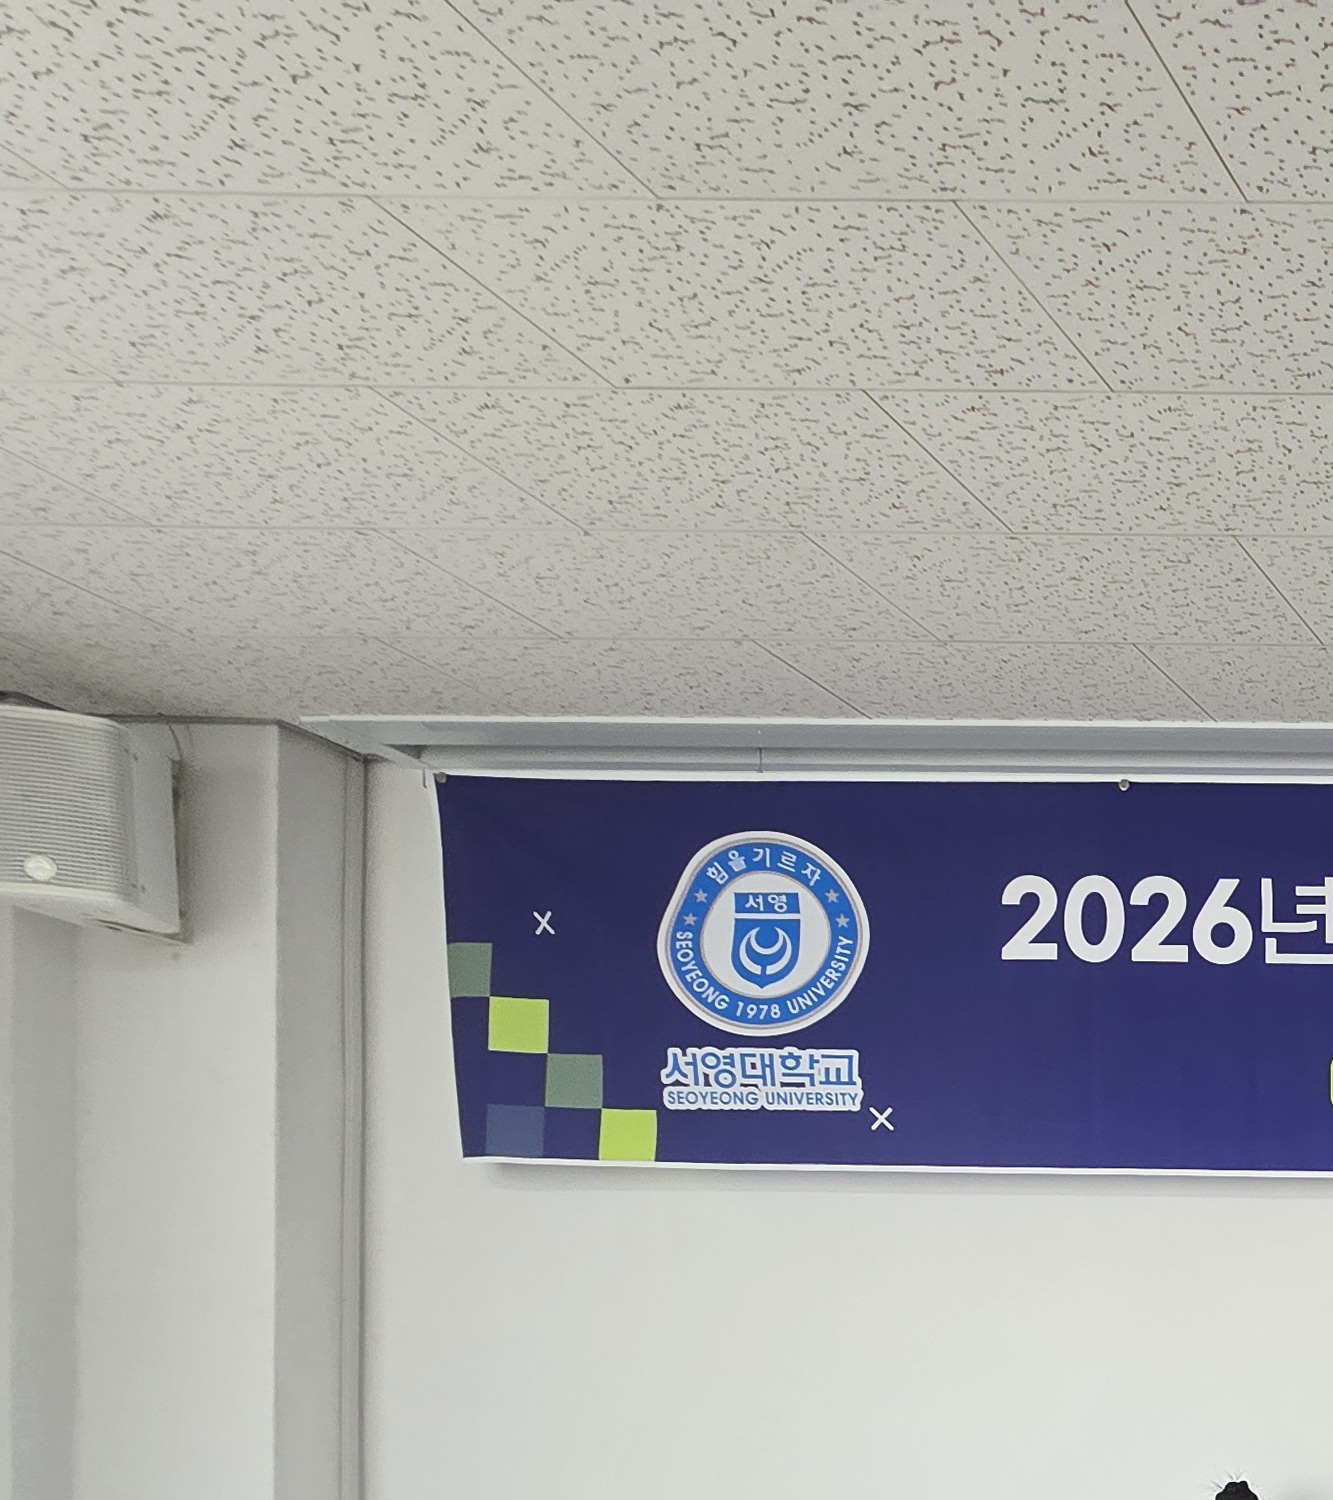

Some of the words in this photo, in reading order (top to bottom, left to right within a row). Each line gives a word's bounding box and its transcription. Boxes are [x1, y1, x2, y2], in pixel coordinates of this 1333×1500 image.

[745, 894, 787, 913] 서영
[676, 931, 730, 1011] SEOYEONG
[736, 1001, 781, 1020] 1978
[787, 935, 853, 1014] UNIVERSITY
[666, 1052, 857, 1088] 서영대학교
[667, 1091, 759, 1106] SEOYEONG
[765, 1092, 858, 1107] UNIVERSITY
